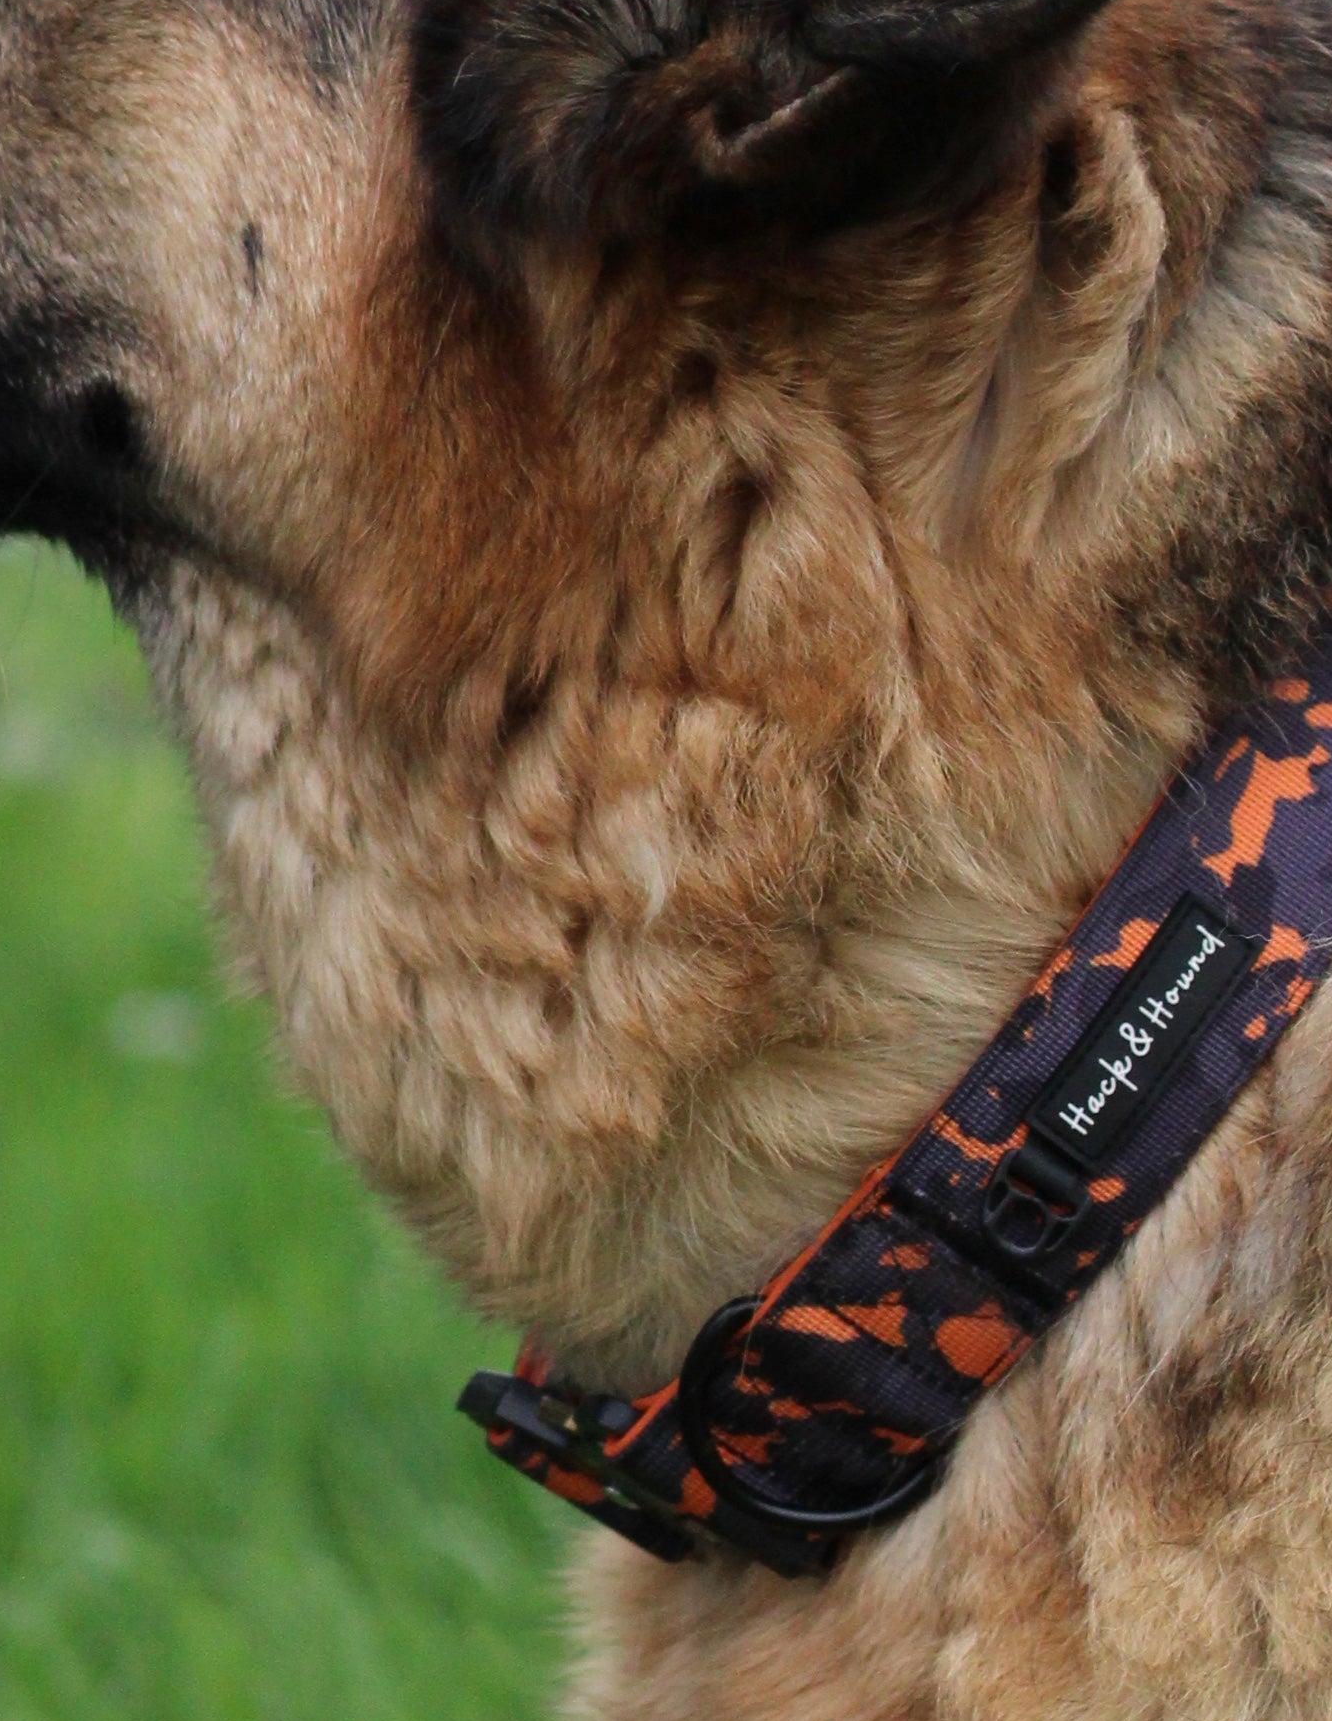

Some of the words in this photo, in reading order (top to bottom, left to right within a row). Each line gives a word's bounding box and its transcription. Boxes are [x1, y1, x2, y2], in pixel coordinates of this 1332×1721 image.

[1059, 1056, 1138, 1135] Hack
[1119, 1022, 1154, 1056] &
[1139, 925, 1225, 1029] Hound
